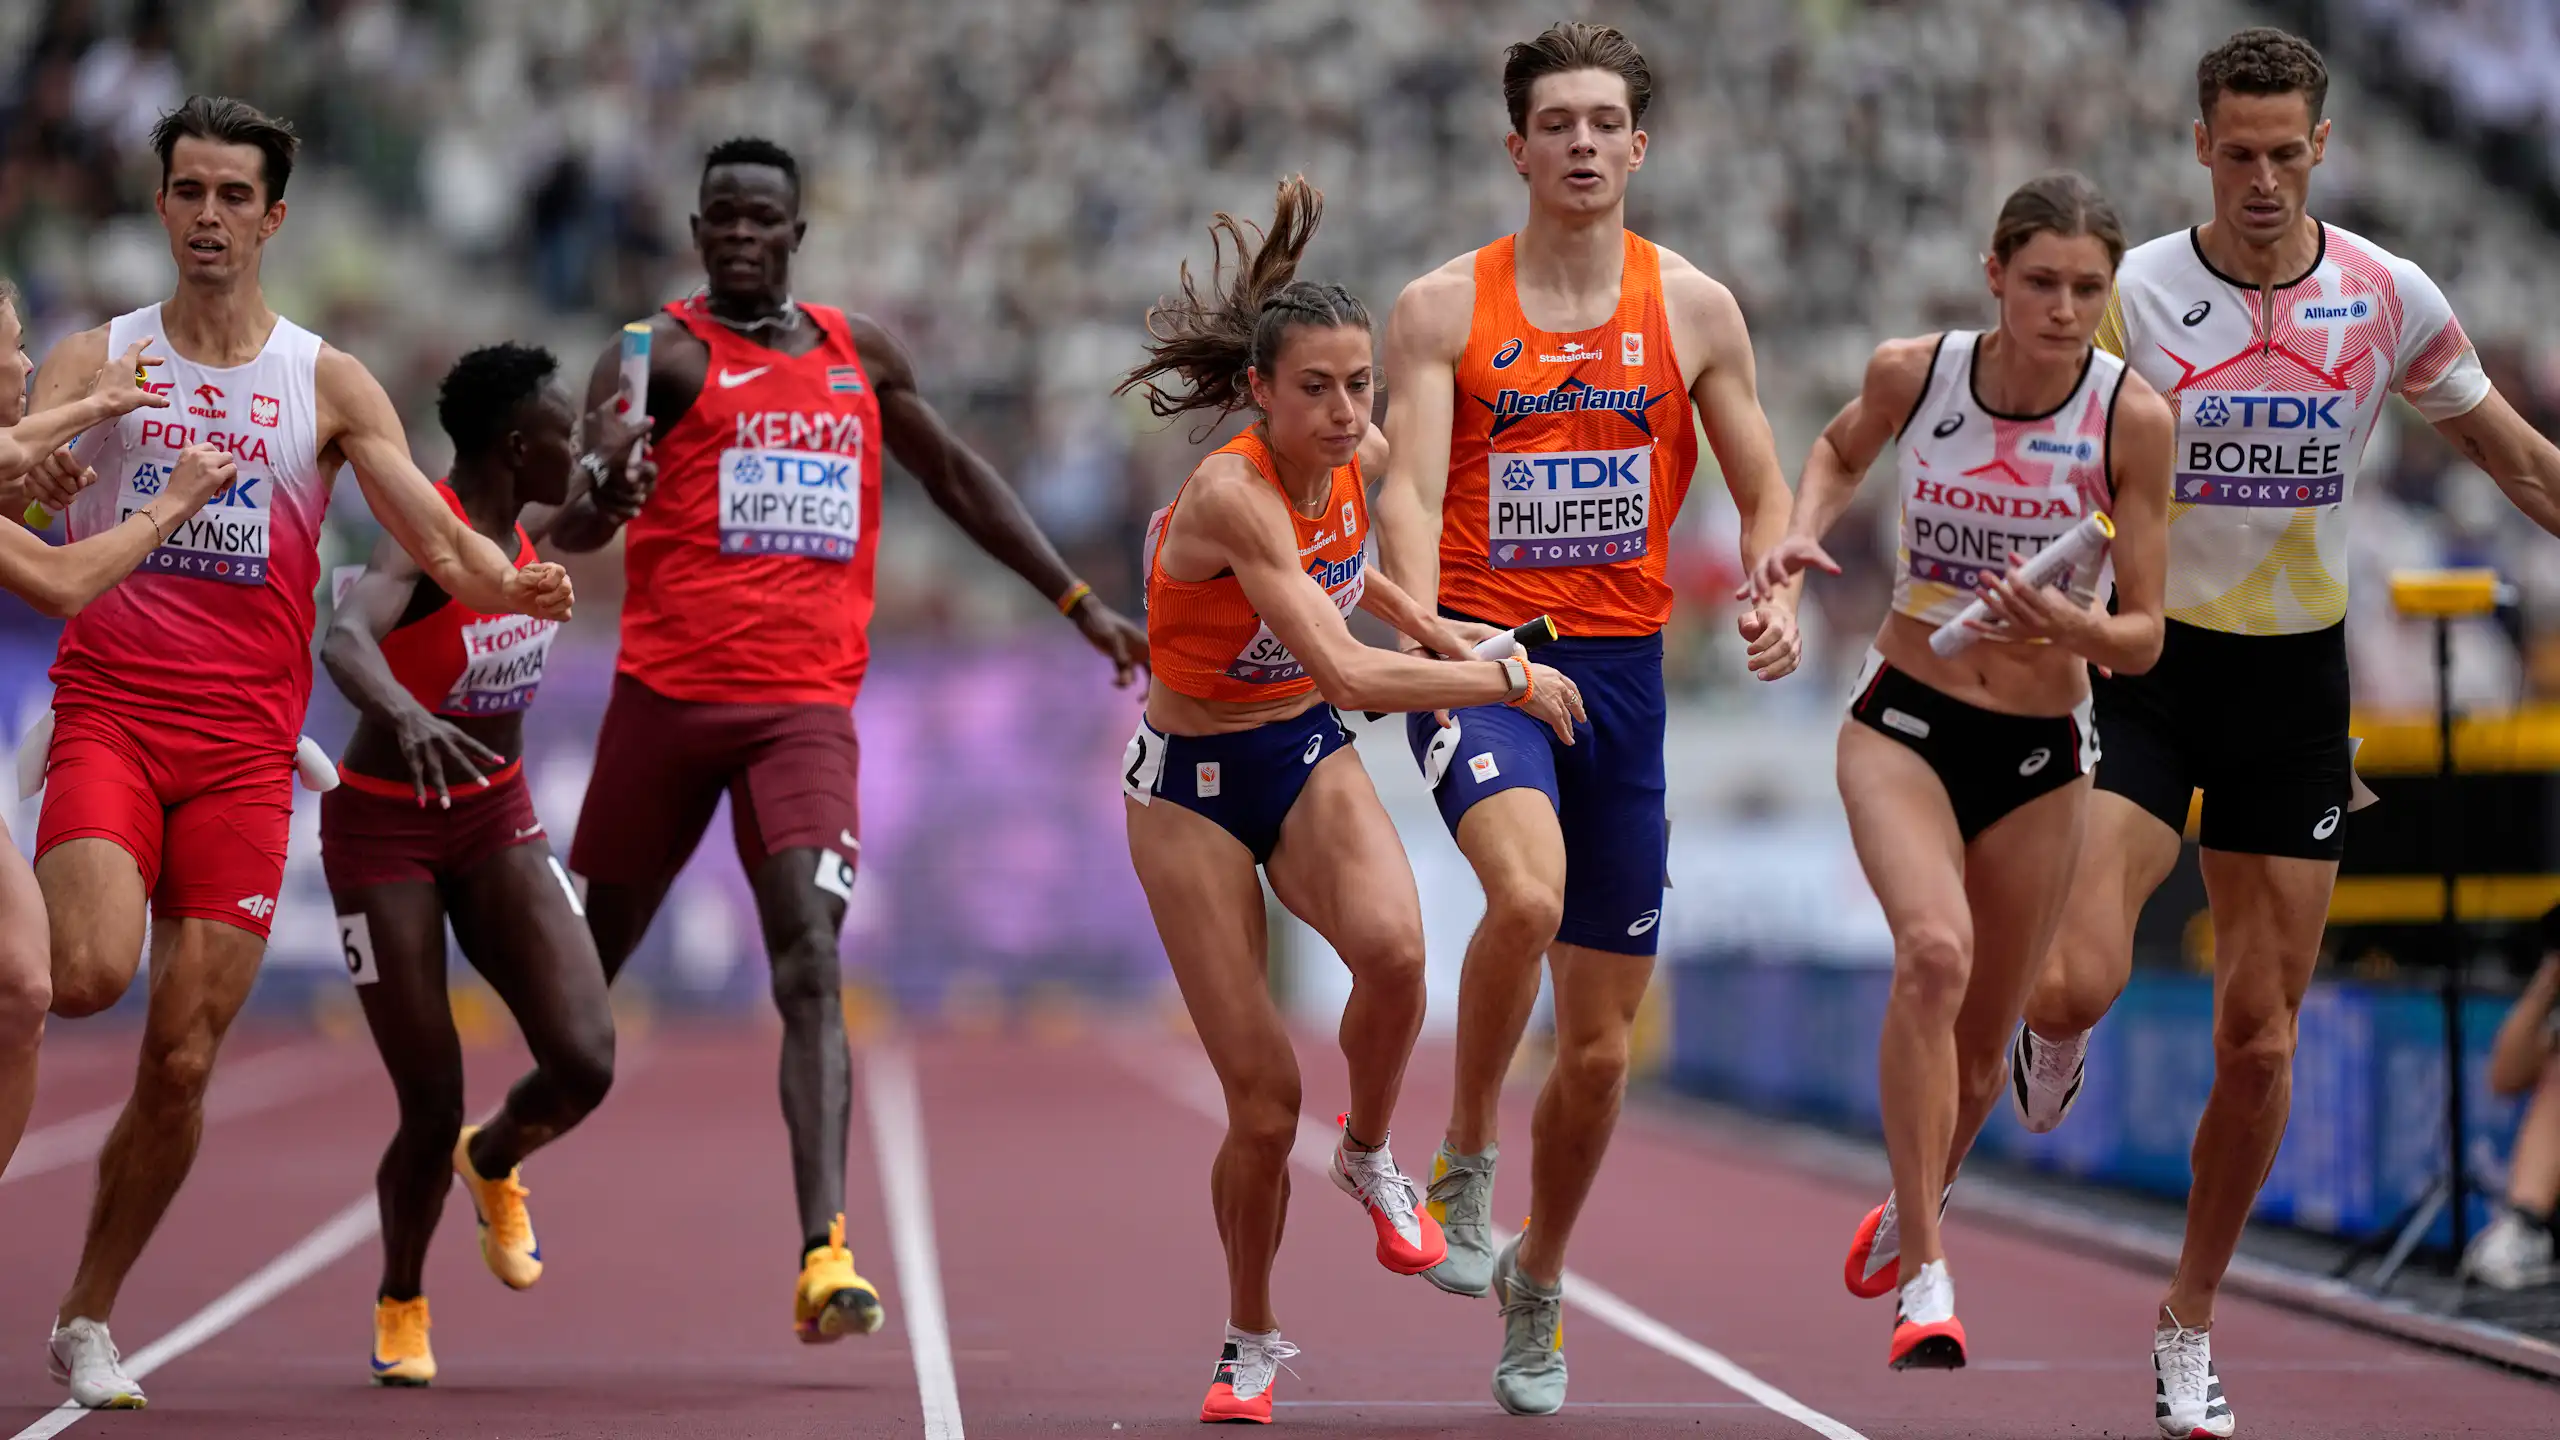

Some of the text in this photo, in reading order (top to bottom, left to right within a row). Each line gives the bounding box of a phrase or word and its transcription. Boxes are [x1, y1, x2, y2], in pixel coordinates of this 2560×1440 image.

[2304, 307, 2348, 320] Allianz
[1539, 349, 1603, 363] Staatsloterij
[188, 404, 226, 419] ORLEN
[2230, 396, 2342, 430] TDK
[735, 411, 863, 457] KENYA
[2028, 439, 2073, 455] Allianz
[765, 456, 849, 492] TDK
[1533, 453, 1640, 490] TDK
[2189, 437, 2341, 475] BORLÉE
[730, 493, 854, 530] KIPYEGO
[1498, 493, 1644, 534] PHIJFFERS
[1913, 479, 2076, 519] HONDA
[1915, 517, 2063, 562] PONETT
[1126, 735, 1146, 789] 2
[342, 927, 362, 976] 6
